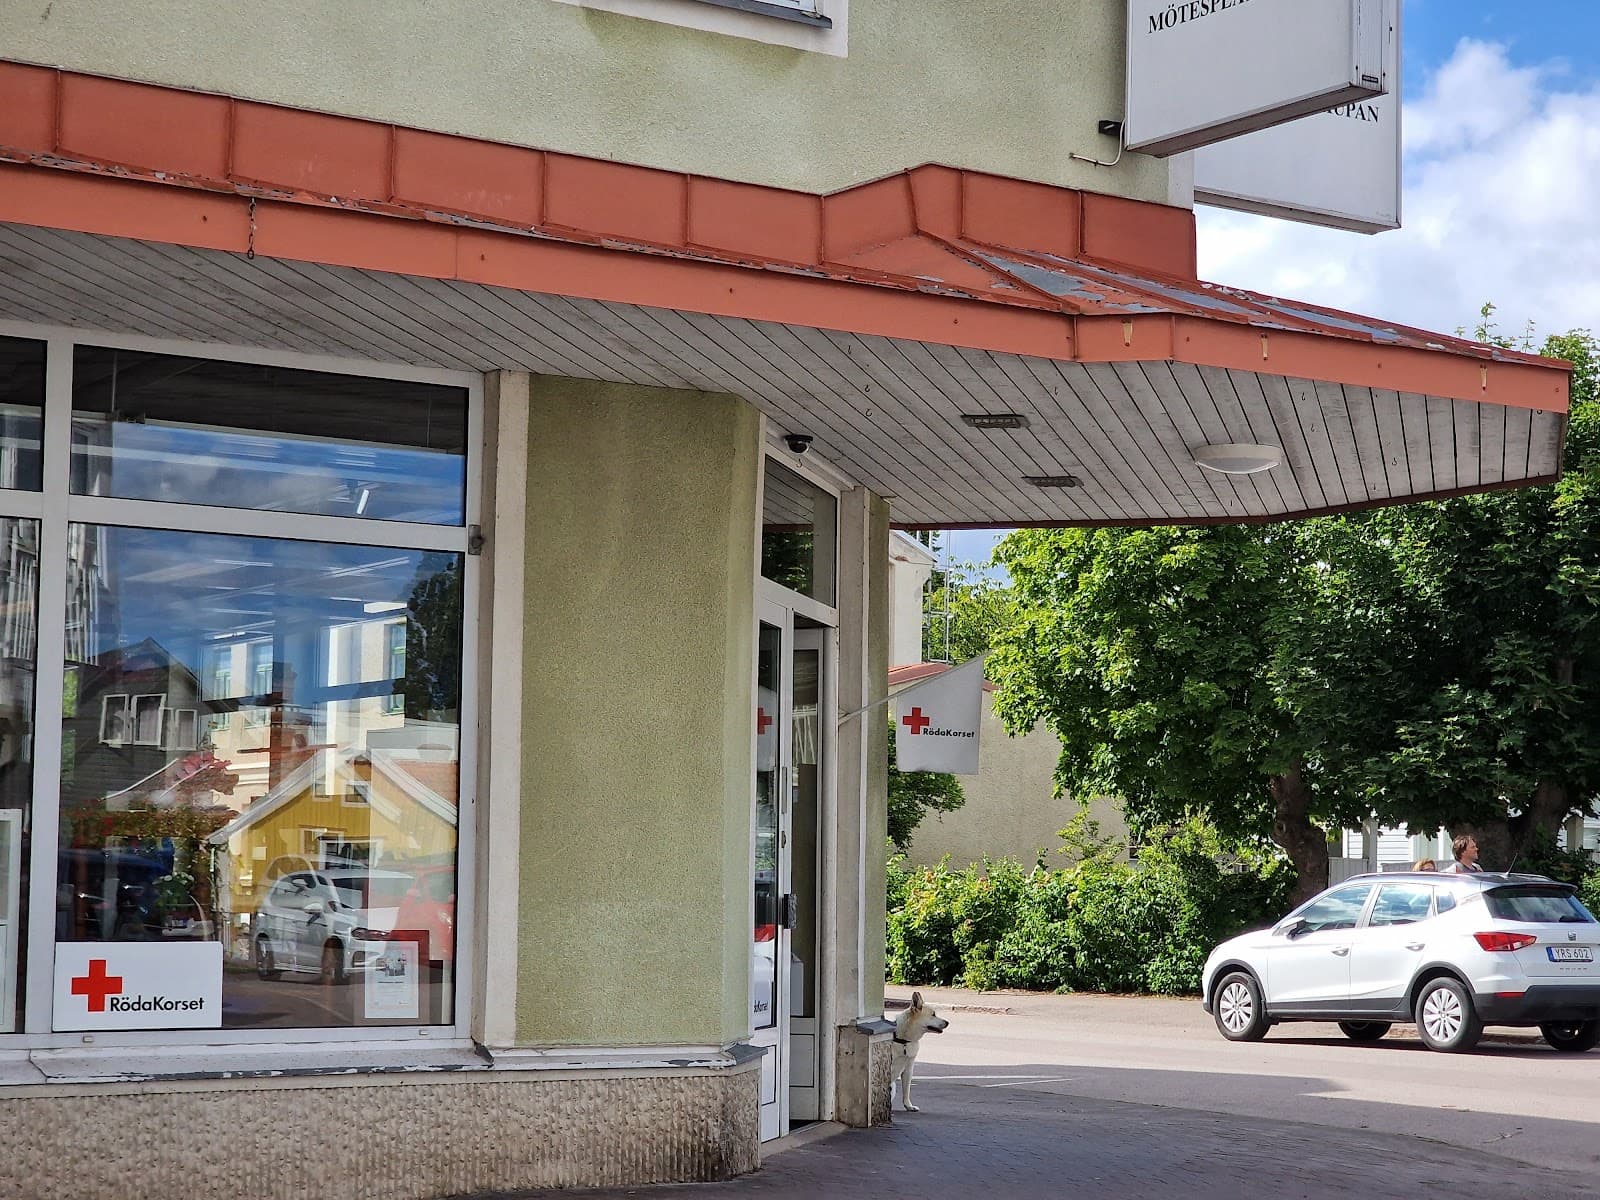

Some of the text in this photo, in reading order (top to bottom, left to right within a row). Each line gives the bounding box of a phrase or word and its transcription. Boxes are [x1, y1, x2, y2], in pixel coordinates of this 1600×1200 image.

[1148, 0, 1250, 34] MÖTESPL
[1327, 102, 1379, 122] UPAN
[922, 727, 975, 738] RödaKorset
[1555, 948, 1589, 959] YRS 602
[110, 995, 205, 1012] RödaKorset
